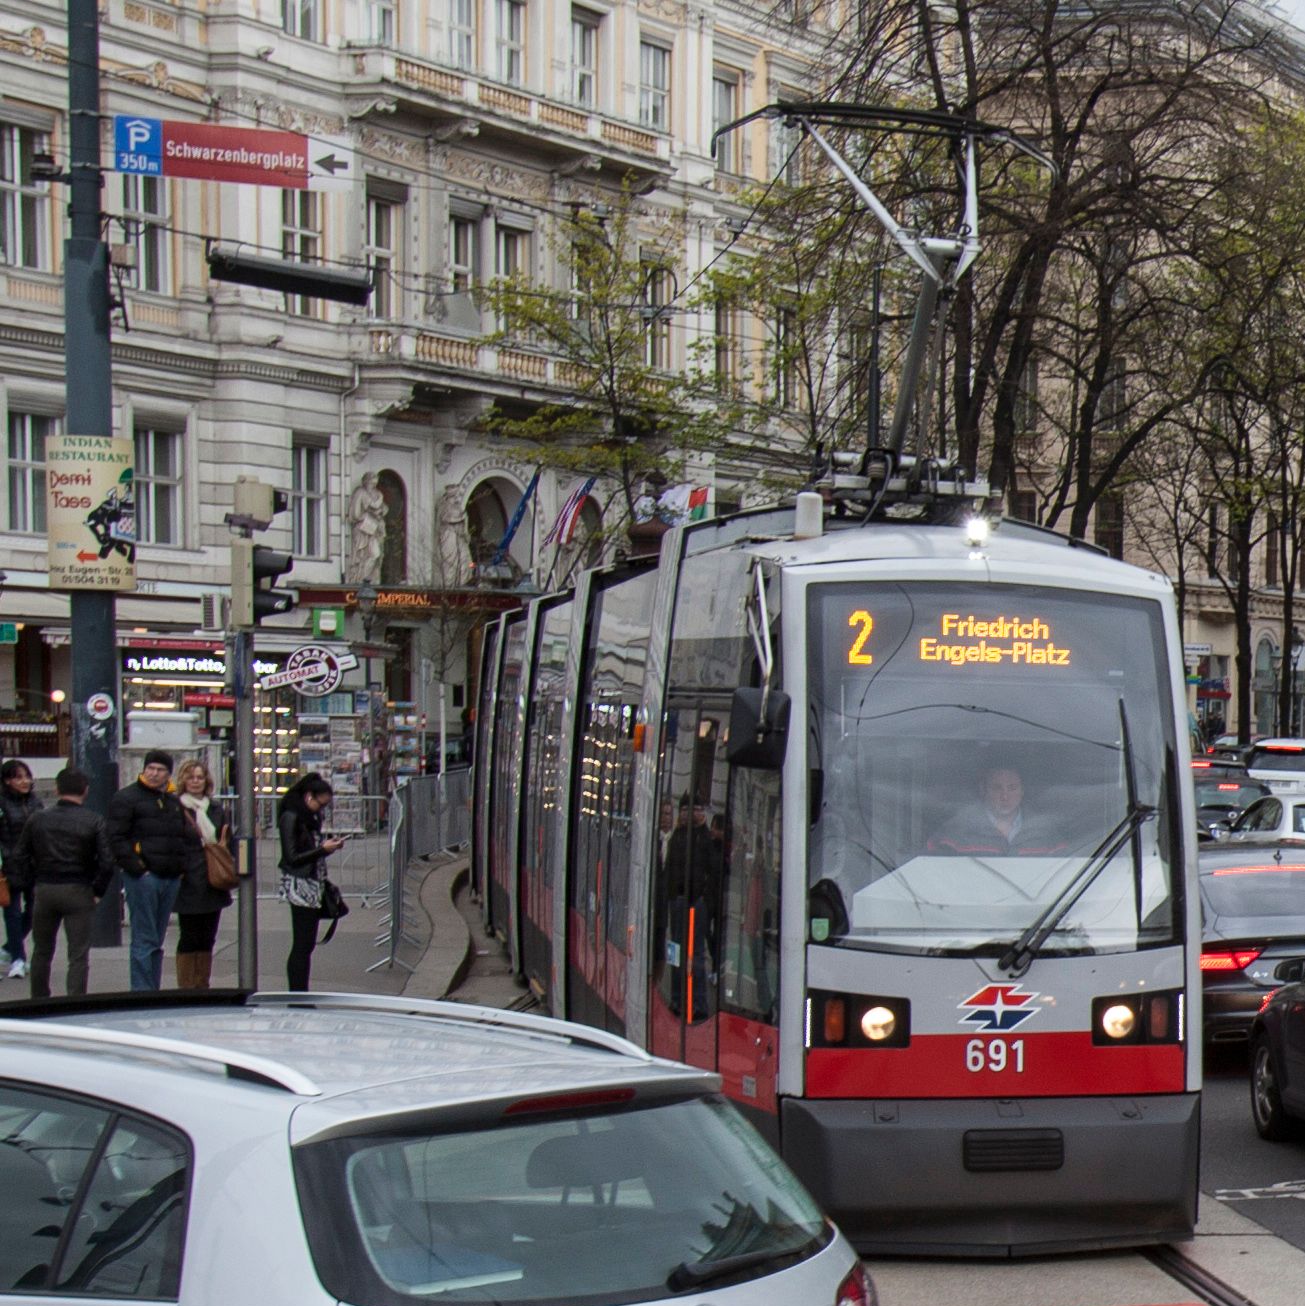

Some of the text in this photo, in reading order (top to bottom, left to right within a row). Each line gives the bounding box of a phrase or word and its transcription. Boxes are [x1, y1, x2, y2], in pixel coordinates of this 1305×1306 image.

[166, 140, 305, 169] Schwarzenbergplatz
[63, 437, 112, 449] INDIAN
[49, 450, 129, 464] RESTAURANT
[50, 468, 92, 489] Demi
[377, 592, 431, 606] IMPERIAL
[849, 610, 873, 664] 2
[942, 614, 1049, 640] Friedrich
[919, 637, 1071, 666] Engels-Platz
[268, 666, 320, 686] AUTOMAT
[966, 1038, 1024, 1073] 691
